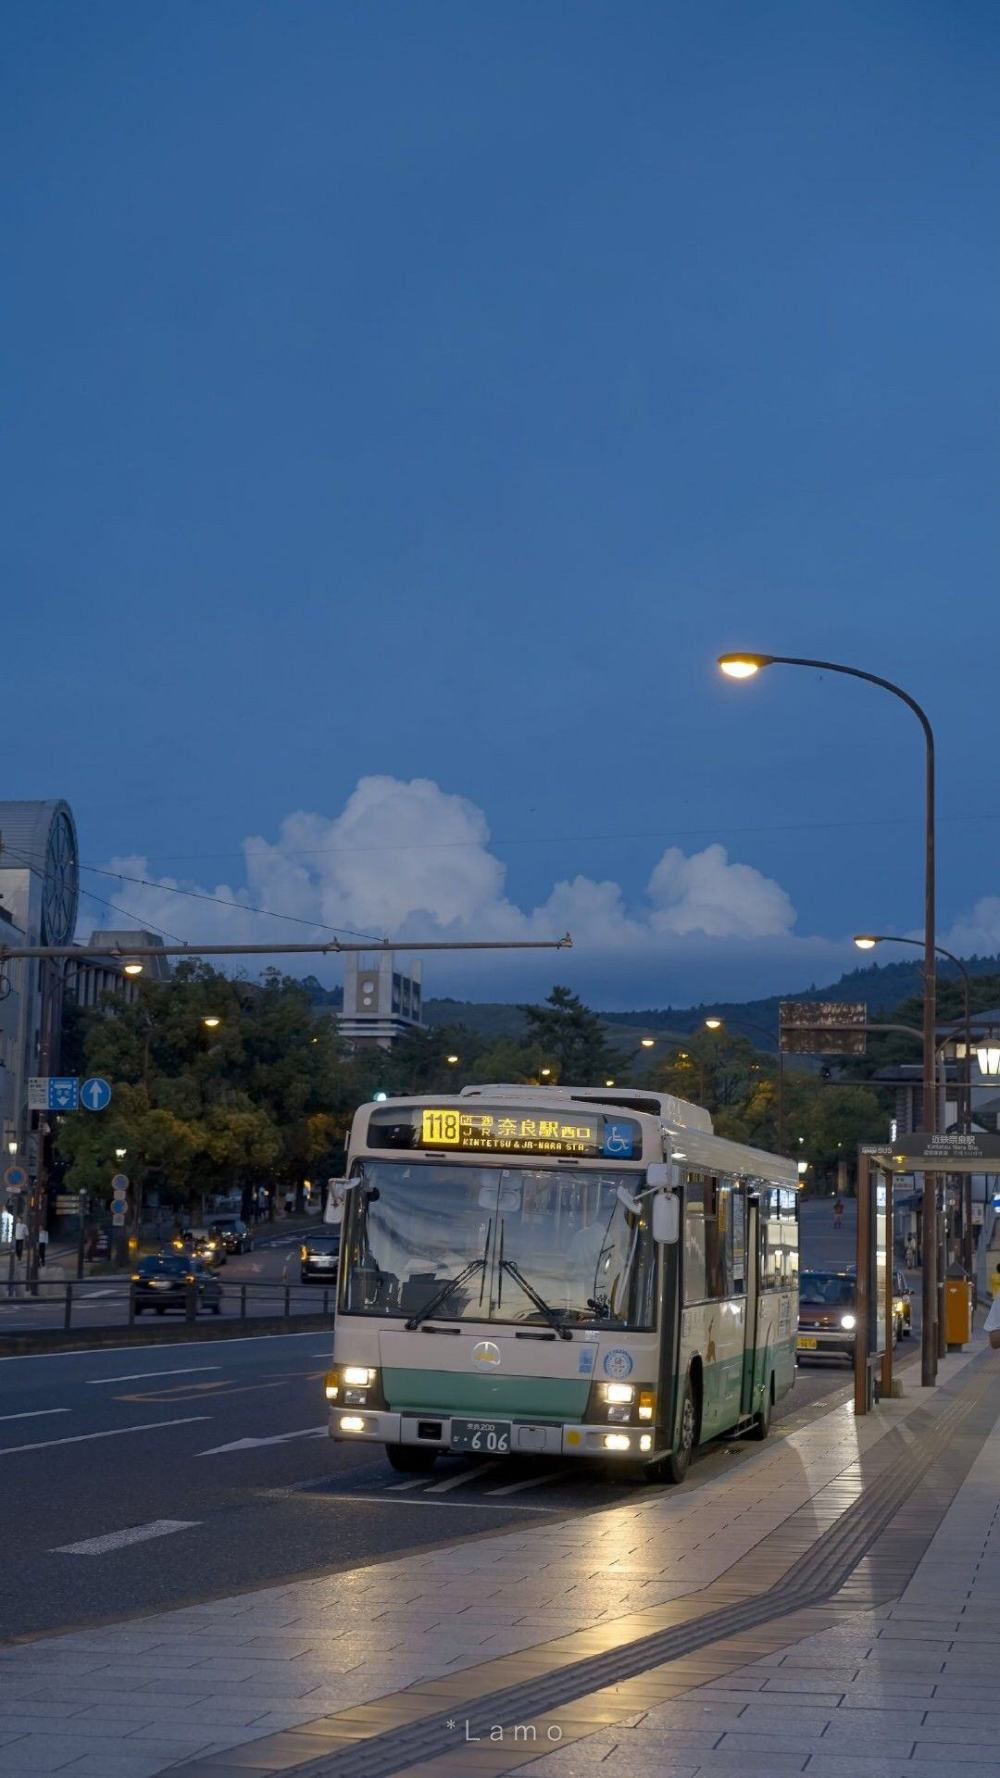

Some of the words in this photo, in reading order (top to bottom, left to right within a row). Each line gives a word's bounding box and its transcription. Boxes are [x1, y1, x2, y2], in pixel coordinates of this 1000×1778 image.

[426, 1114, 456, 1139] 118
[497, 1118, 591, 1138] 奈良駅西口
[463, 1138, 512, 1148] KINTETSU
[472, 1431, 508, 1451] 606
